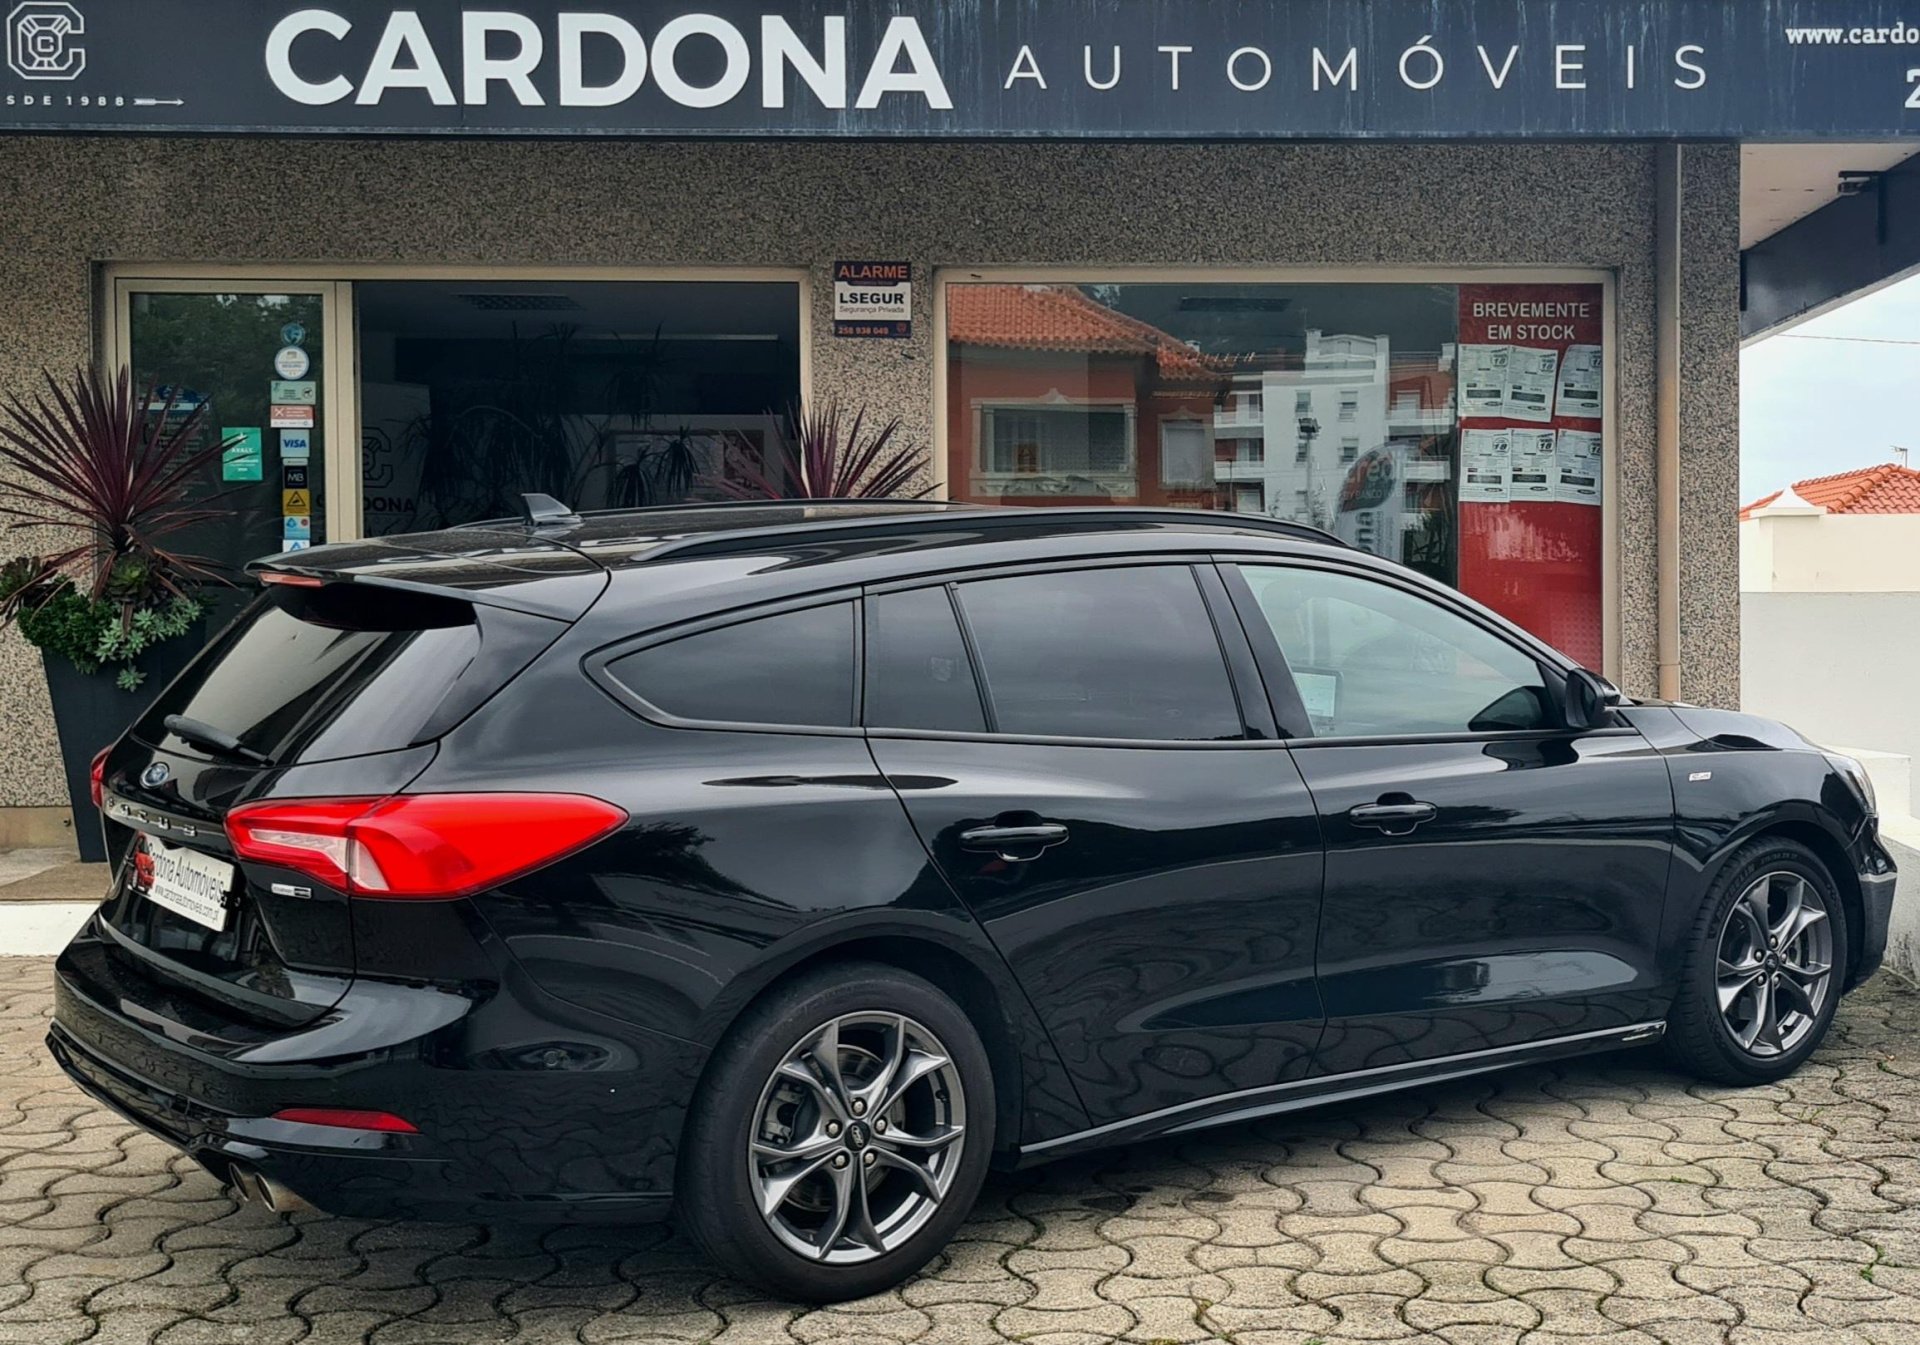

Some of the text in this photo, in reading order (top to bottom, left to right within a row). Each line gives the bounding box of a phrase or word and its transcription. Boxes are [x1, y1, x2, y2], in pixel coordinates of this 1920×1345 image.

[264, 9, 954, 109] CARDONA
[1004, 35, 1708, 92] AUTOMÓVEIS
[66, 96, 124, 107] 1988
[838, 265, 908, 279] ALARME
[839, 292, 904, 304] LSEGUR
[839, 306, 877, 314] Segurança
[1473, 302, 1590, 318] BREVEMENTE
[1487, 324, 1576, 340] EM STOCK
[283, 439, 307, 448] VISA
[287, 473, 305, 482] MB
[173, 855, 225, 904] Automóveis
